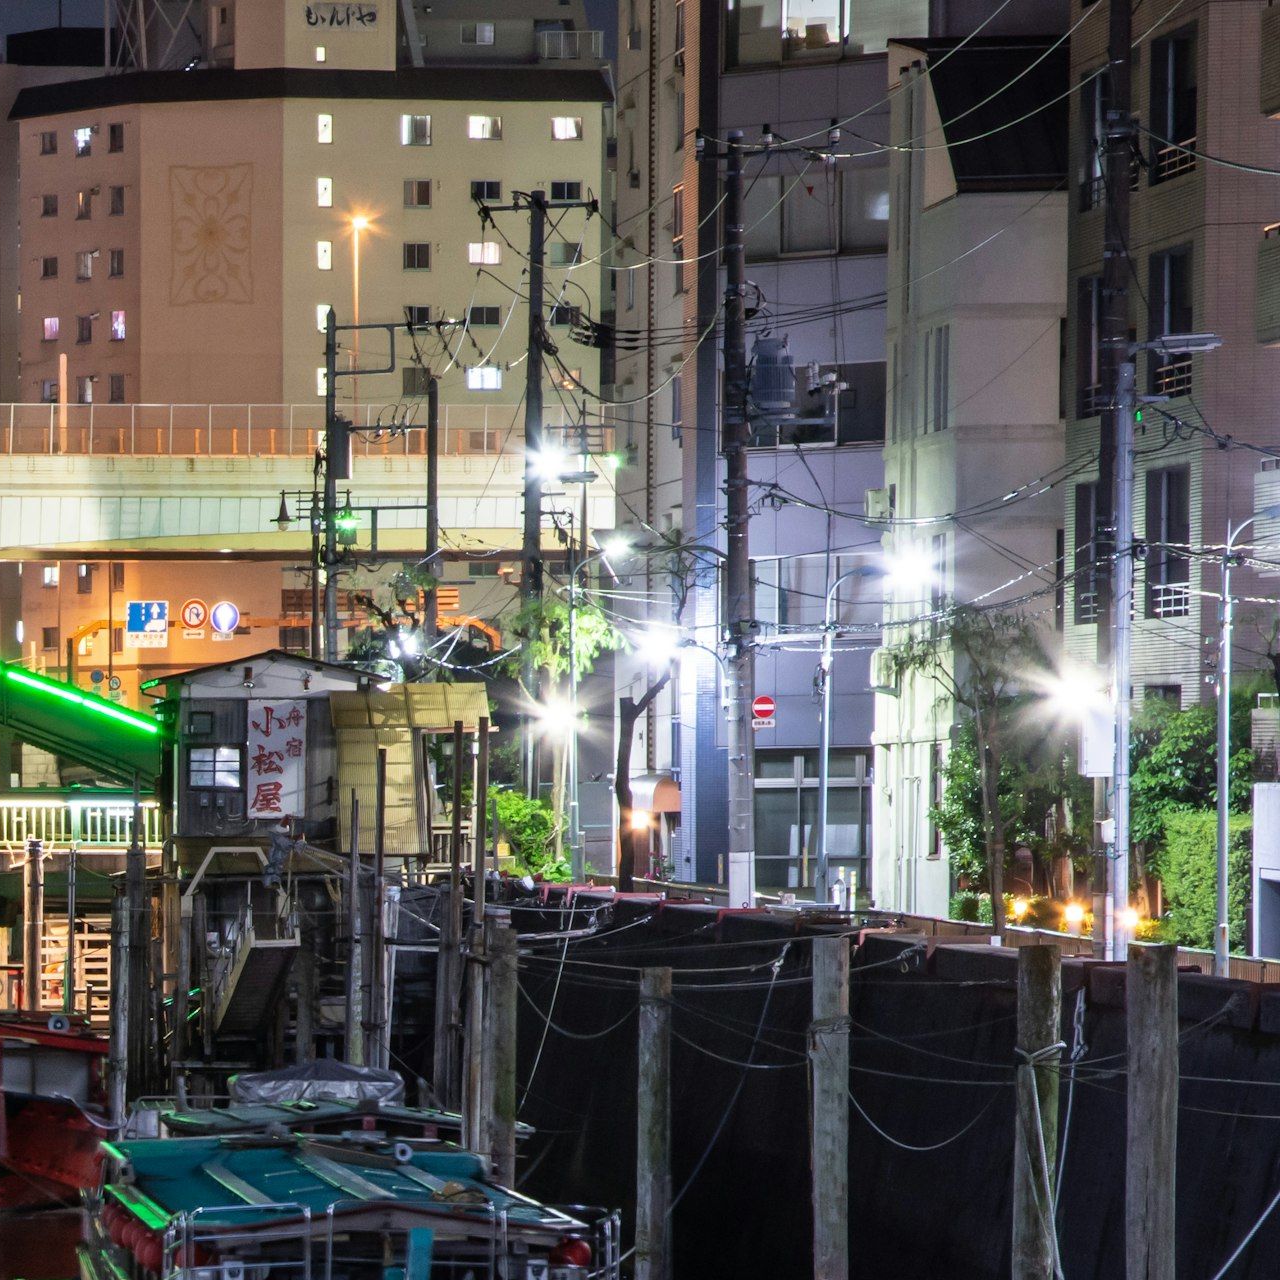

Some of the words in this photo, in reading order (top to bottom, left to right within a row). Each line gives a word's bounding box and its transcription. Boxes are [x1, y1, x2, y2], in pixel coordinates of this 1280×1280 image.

[250, 706, 287, 813] 小松屋
[286, 705, 305, 759] 舟宿
